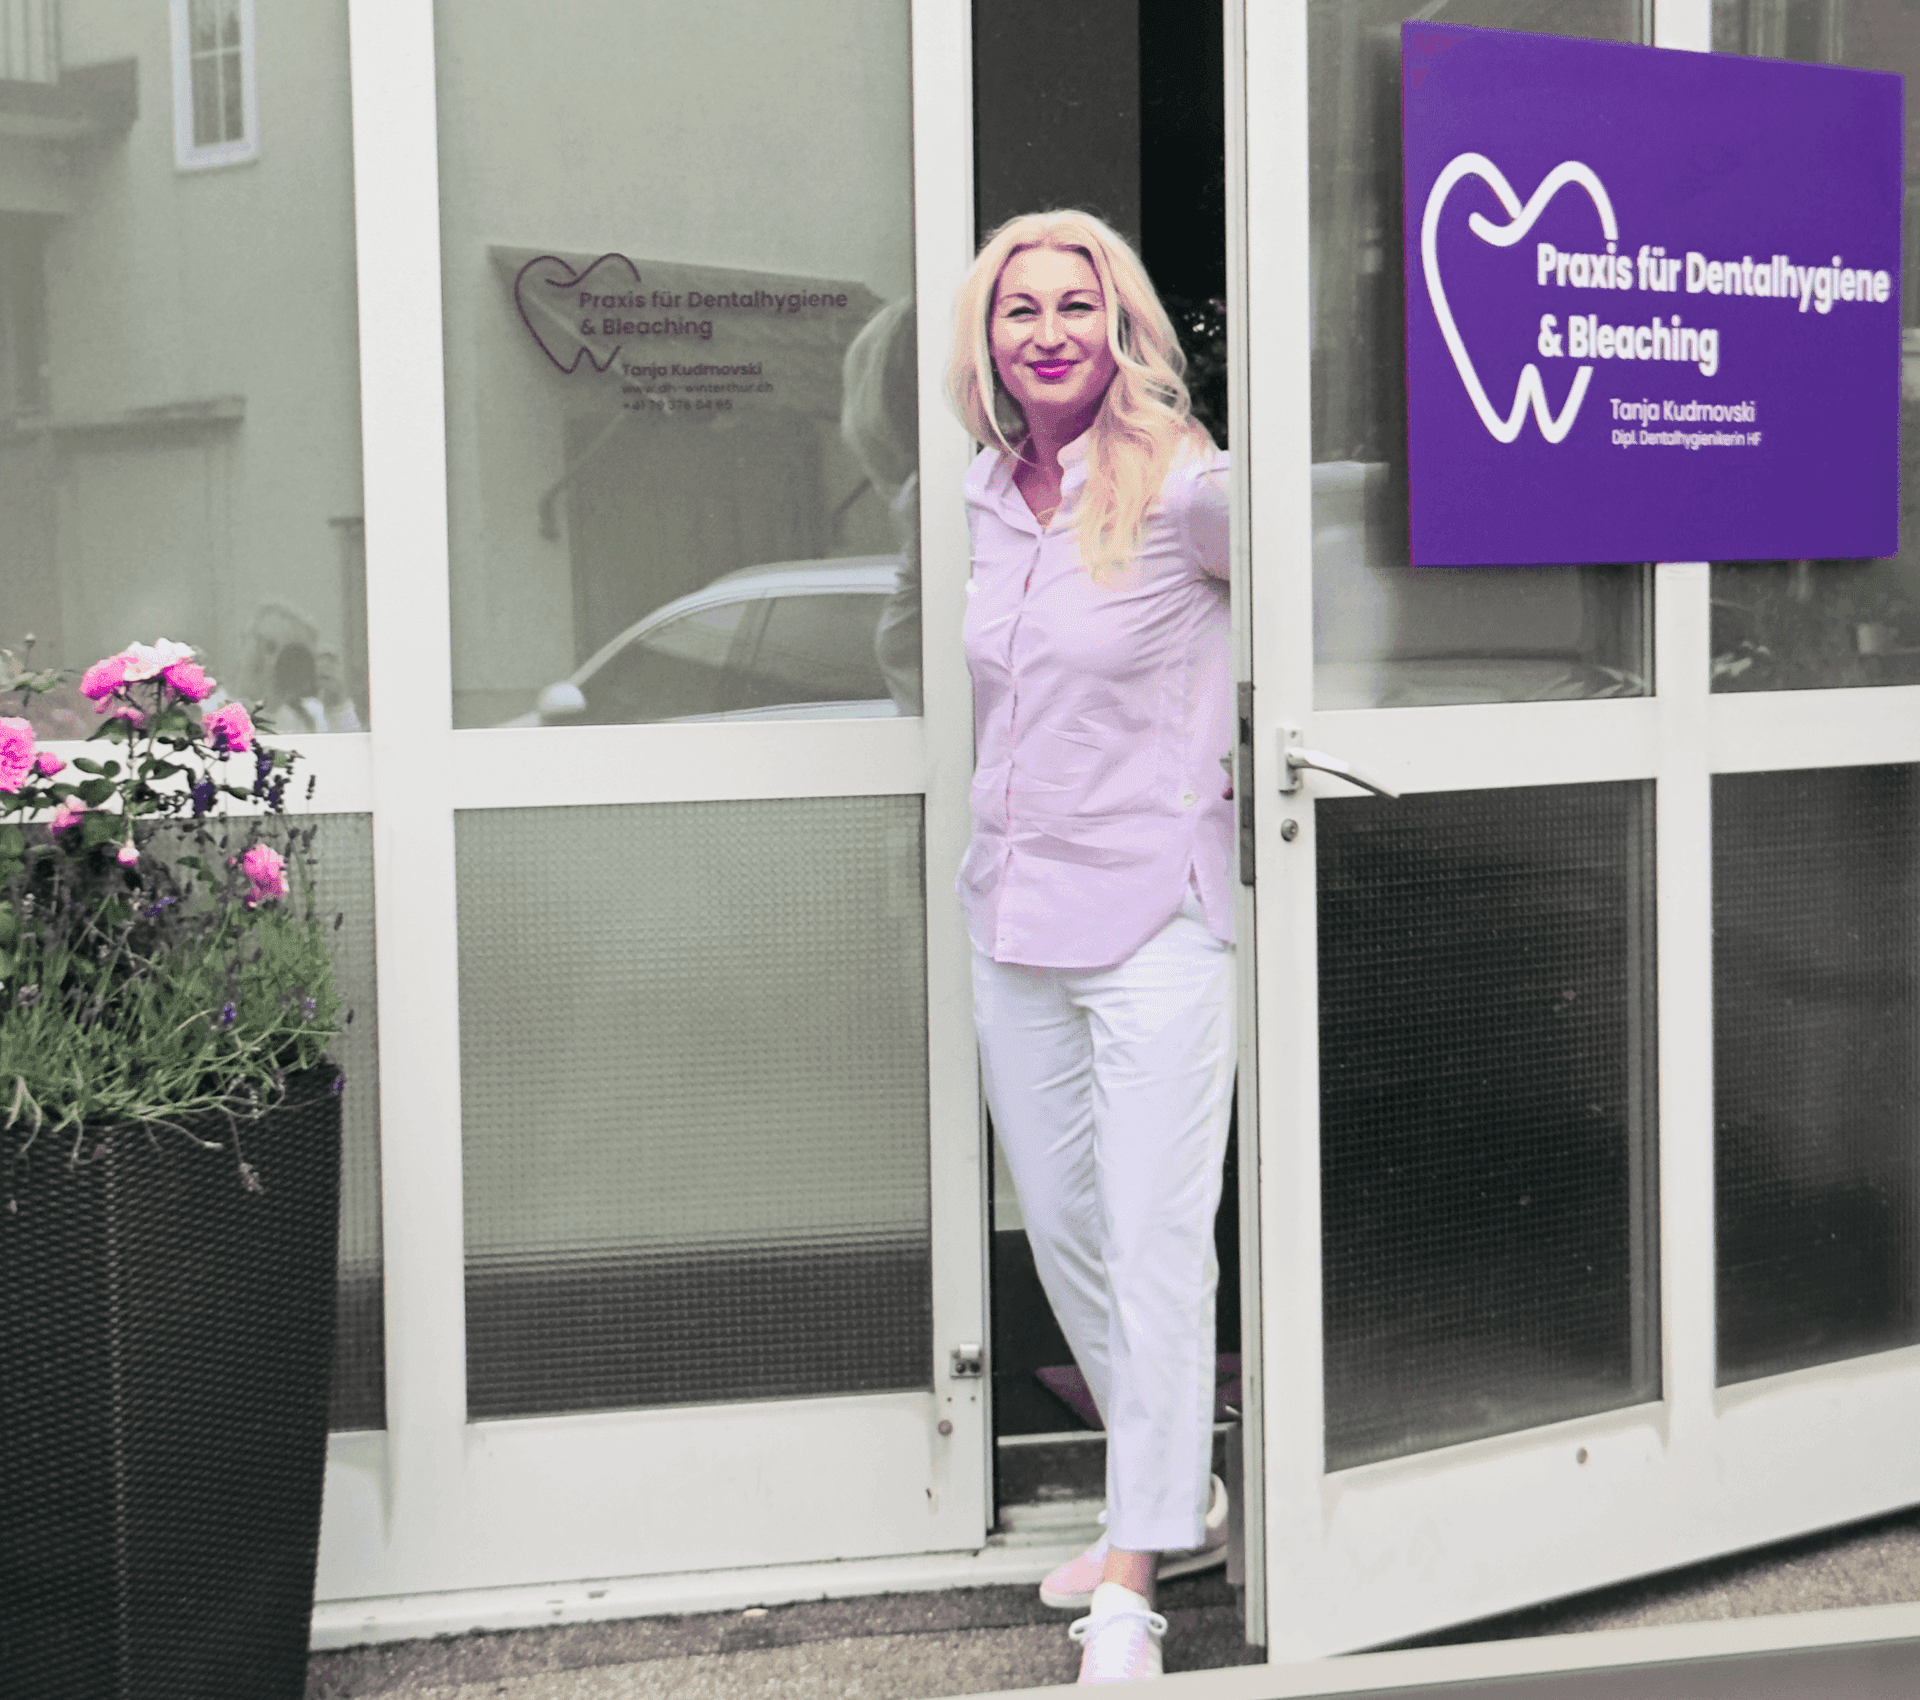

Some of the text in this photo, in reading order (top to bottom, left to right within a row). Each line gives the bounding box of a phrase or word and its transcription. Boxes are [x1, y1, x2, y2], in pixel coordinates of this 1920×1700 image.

[1538, 241, 1891, 313] Praxis für Dentalhygiene
[579, 289, 848, 313] Praxis für Dentalhygiene
[580, 316, 713, 340] & Bleaching
[1538, 313, 1719, 376] & Bleaching
[622, 363, 667, 379] Tanja
[1610, 398, 1660, 427] Tanja
[1612, 429, 1637, 449] Dipl.
[1747, 432, 1762, 446] HF
